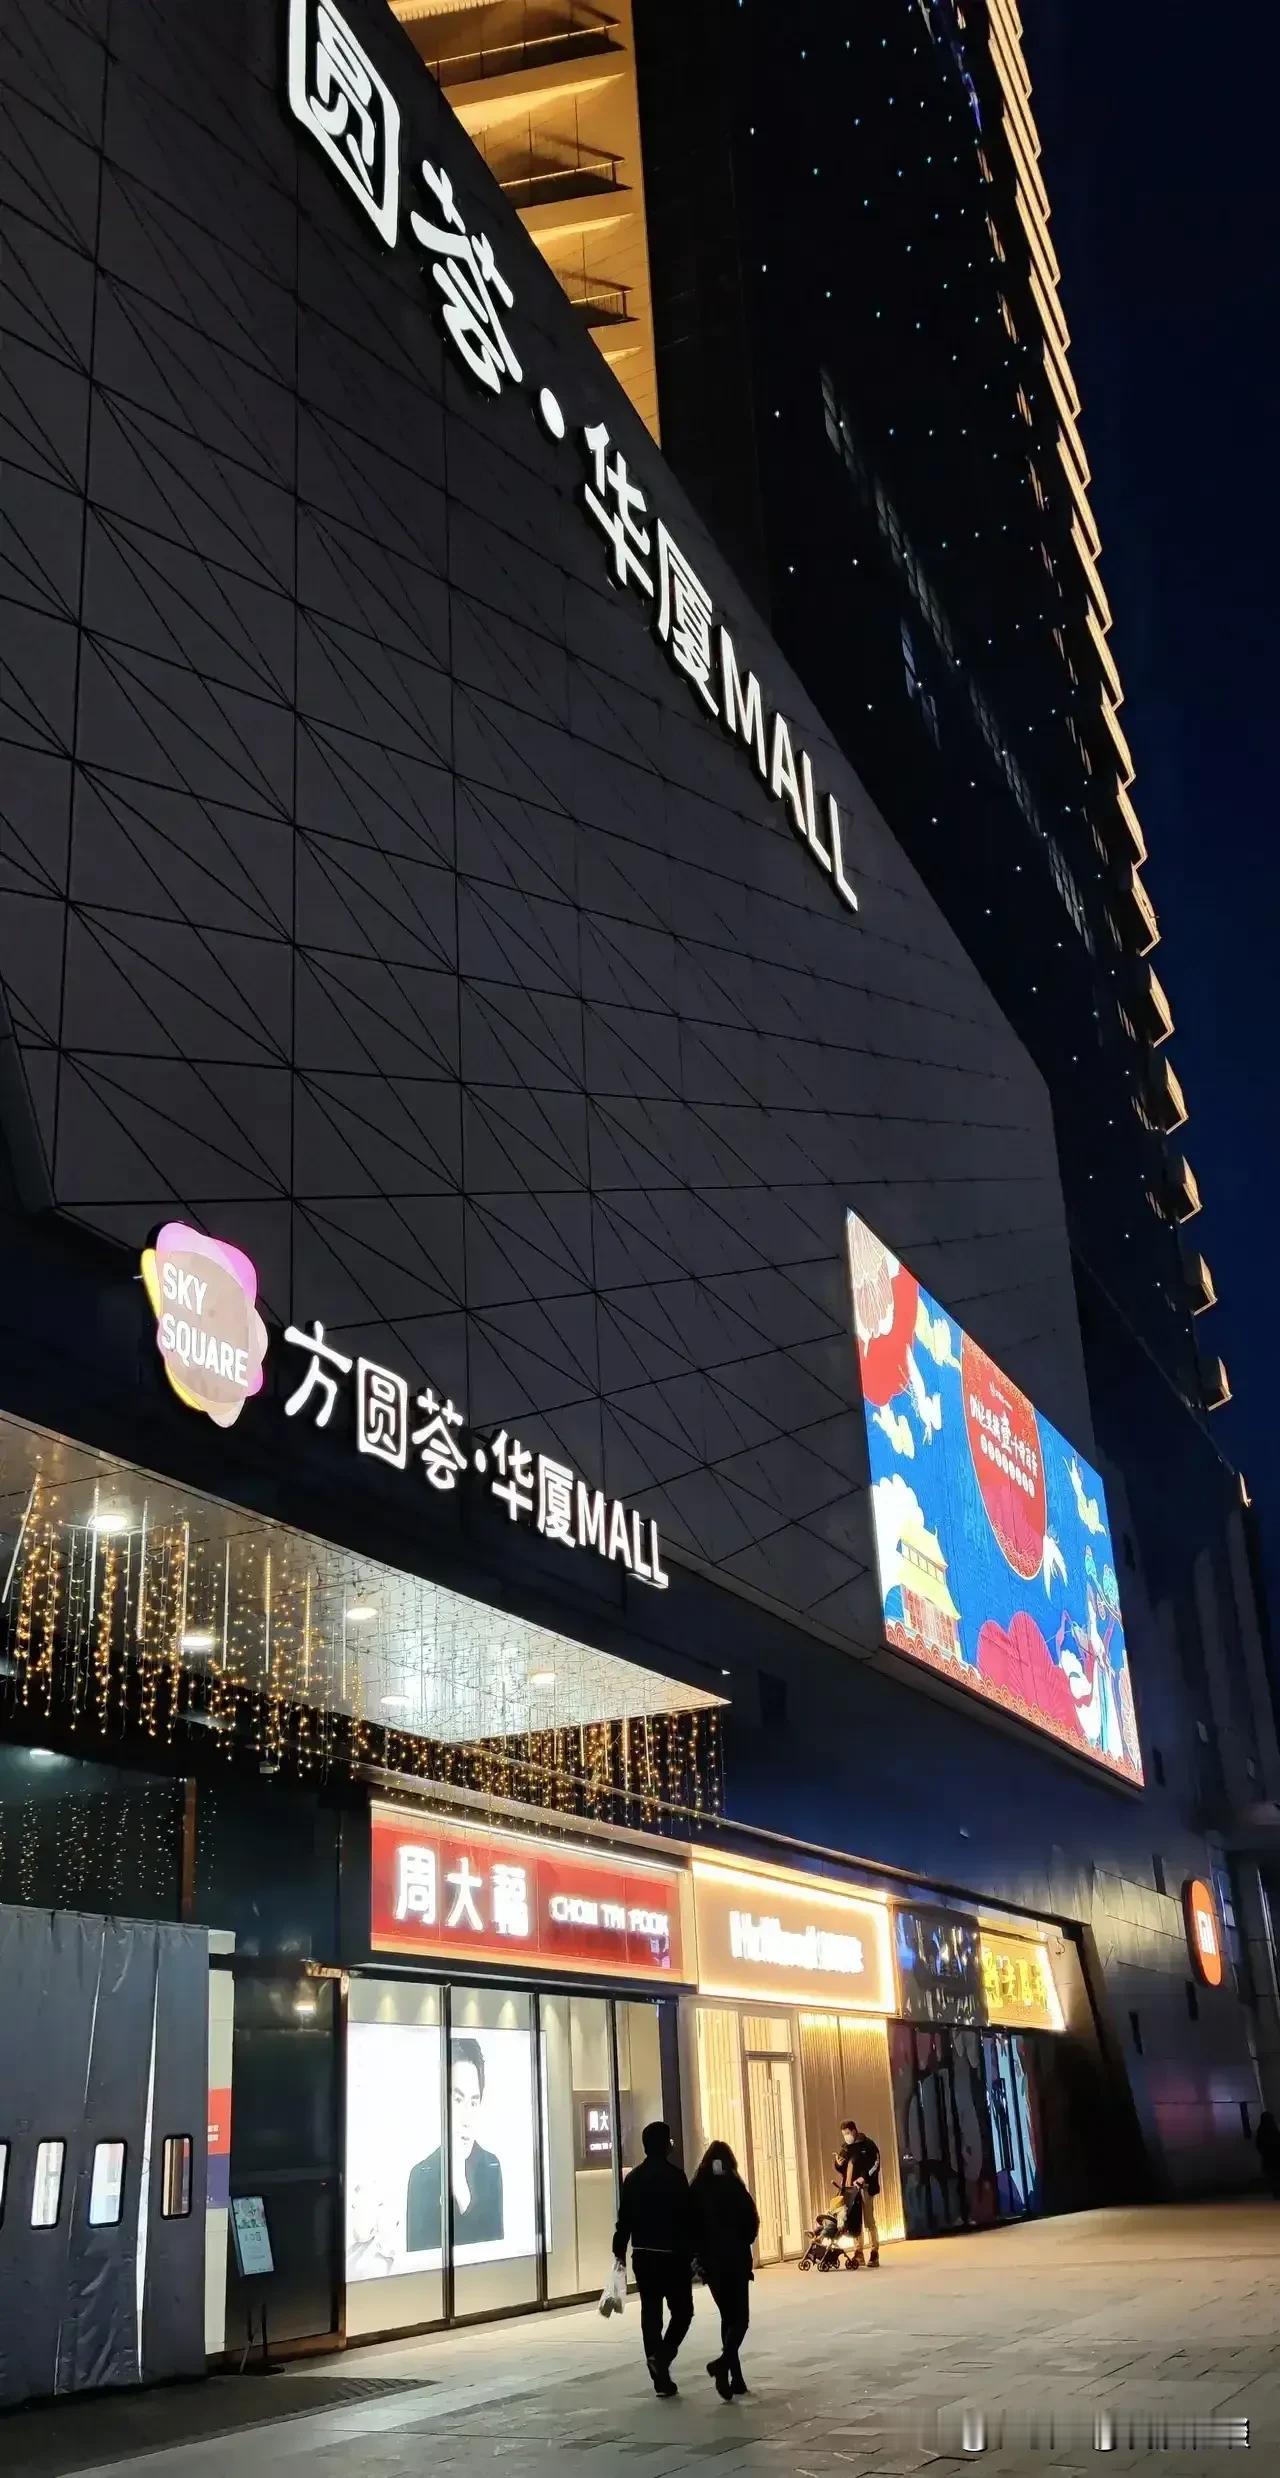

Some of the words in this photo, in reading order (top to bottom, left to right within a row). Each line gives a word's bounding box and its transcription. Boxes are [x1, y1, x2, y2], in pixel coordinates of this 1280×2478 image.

[162, 1262, 208, 1315] SKY
[161, 1312, 249, 1388] SQUARE
[588, 2109, 610, 2132] 周大
